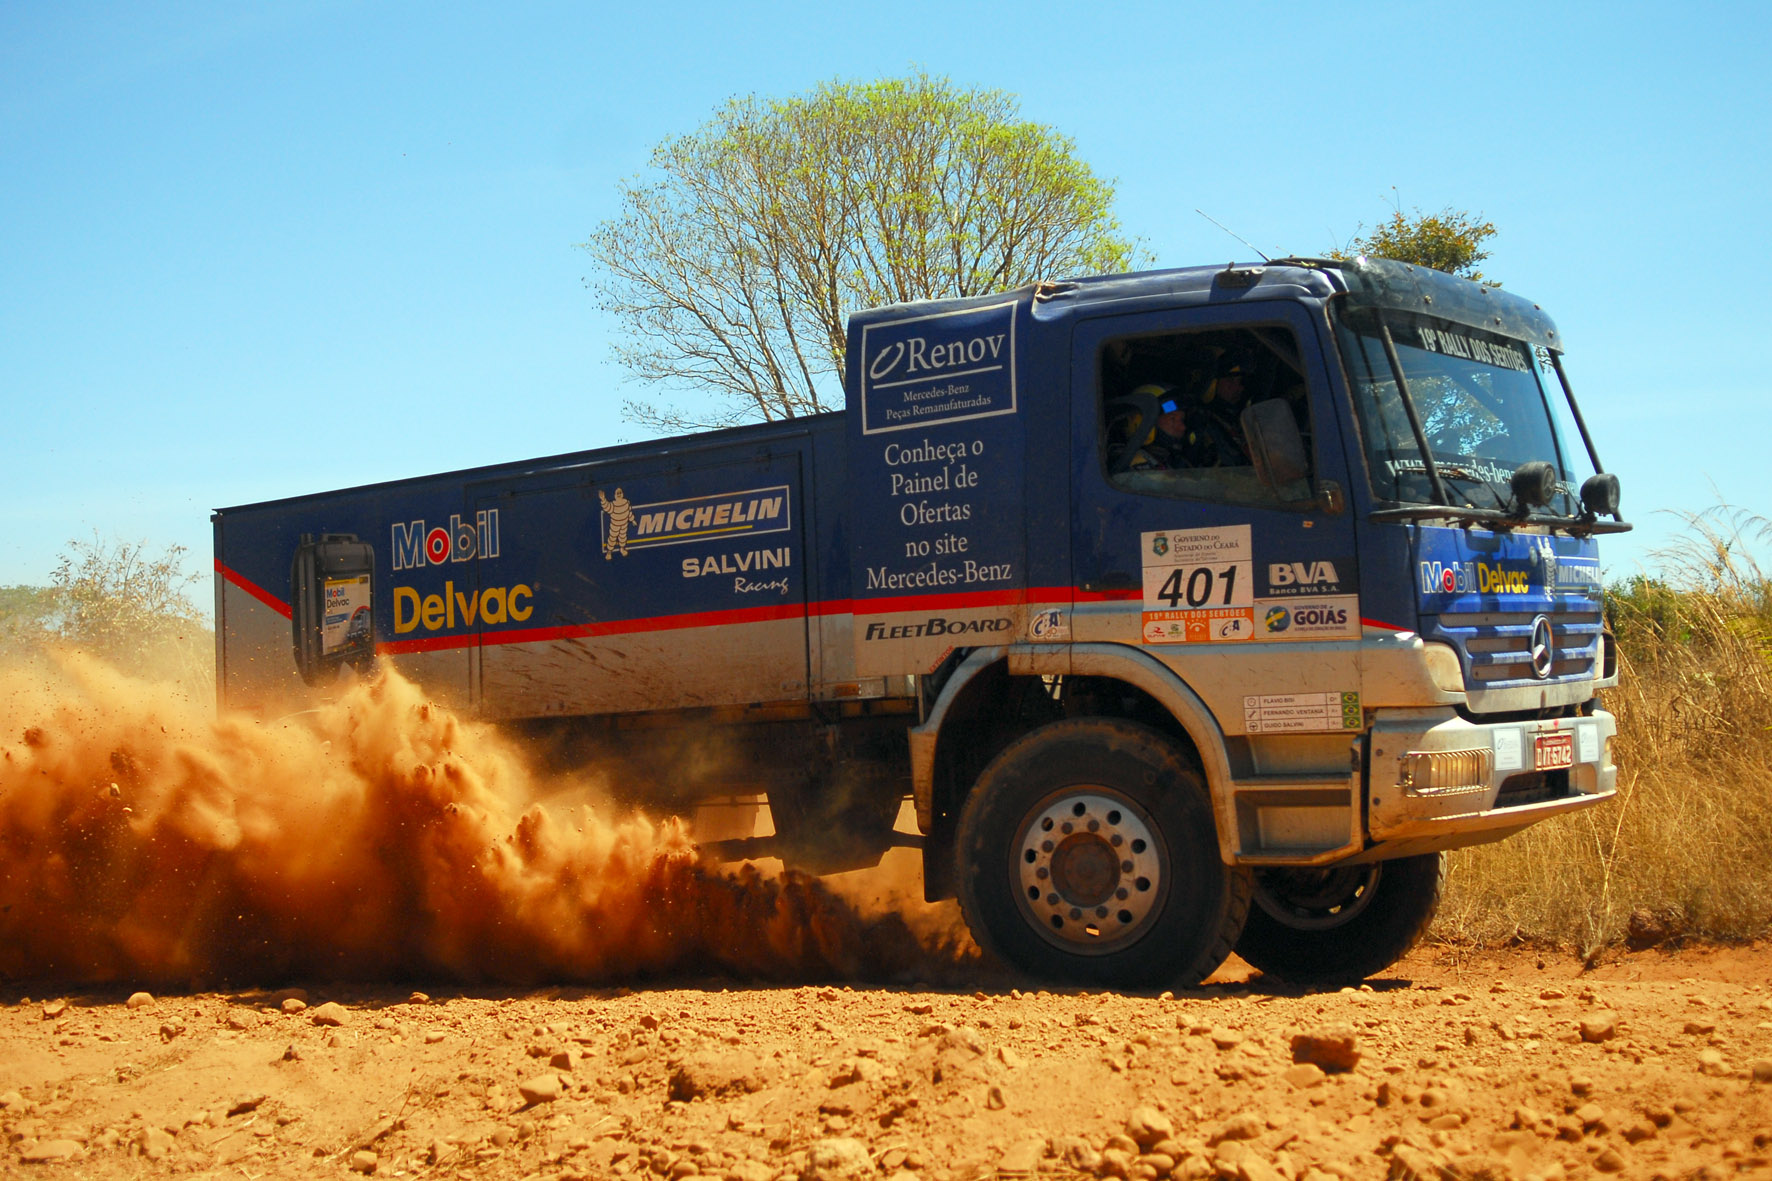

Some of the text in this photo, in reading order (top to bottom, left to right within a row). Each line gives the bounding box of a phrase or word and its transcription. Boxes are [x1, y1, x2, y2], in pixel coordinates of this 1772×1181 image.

[906, 333, 1006, 373] Renov
[1436, 330, 1472, 359] RALLY
[1469, 338, 1492, 364] DOS
[903, 384, 970, 403] Mercedes-Benz
[886, 395, 992, 420] Peças Remanufaturadas
[884, 439, 984, 465] Conheça o
[891, 464, 978, 496] Painel de
[637, 496, 783, 535] MICHELIN
[901, 500, 971, 526] Ofertas
[392, 509, 500, 570] Mobil
[905, 533, 968, 557] no site
[682, 547, 791, 578] SALVINI
[866, 560, 1013, 589] Mercedes-Benz
[1269, 561, 1340, 586] BVA
[734, 577, 789, 595] Racing
[1158, 565, 1237, 608] 401
[1420, 561, 1530, 594] Mobil Delvac
[326, 587, 345, 598] Mobil
[326, 598, 350, 608] Delvac
[394, 581, 534, 634] Delvac
[1165, 611, 1189, 619] RALLY
[1190, 610, 1207, 618] DOS
[1294, 605, 1347, 625] GOIÁS
